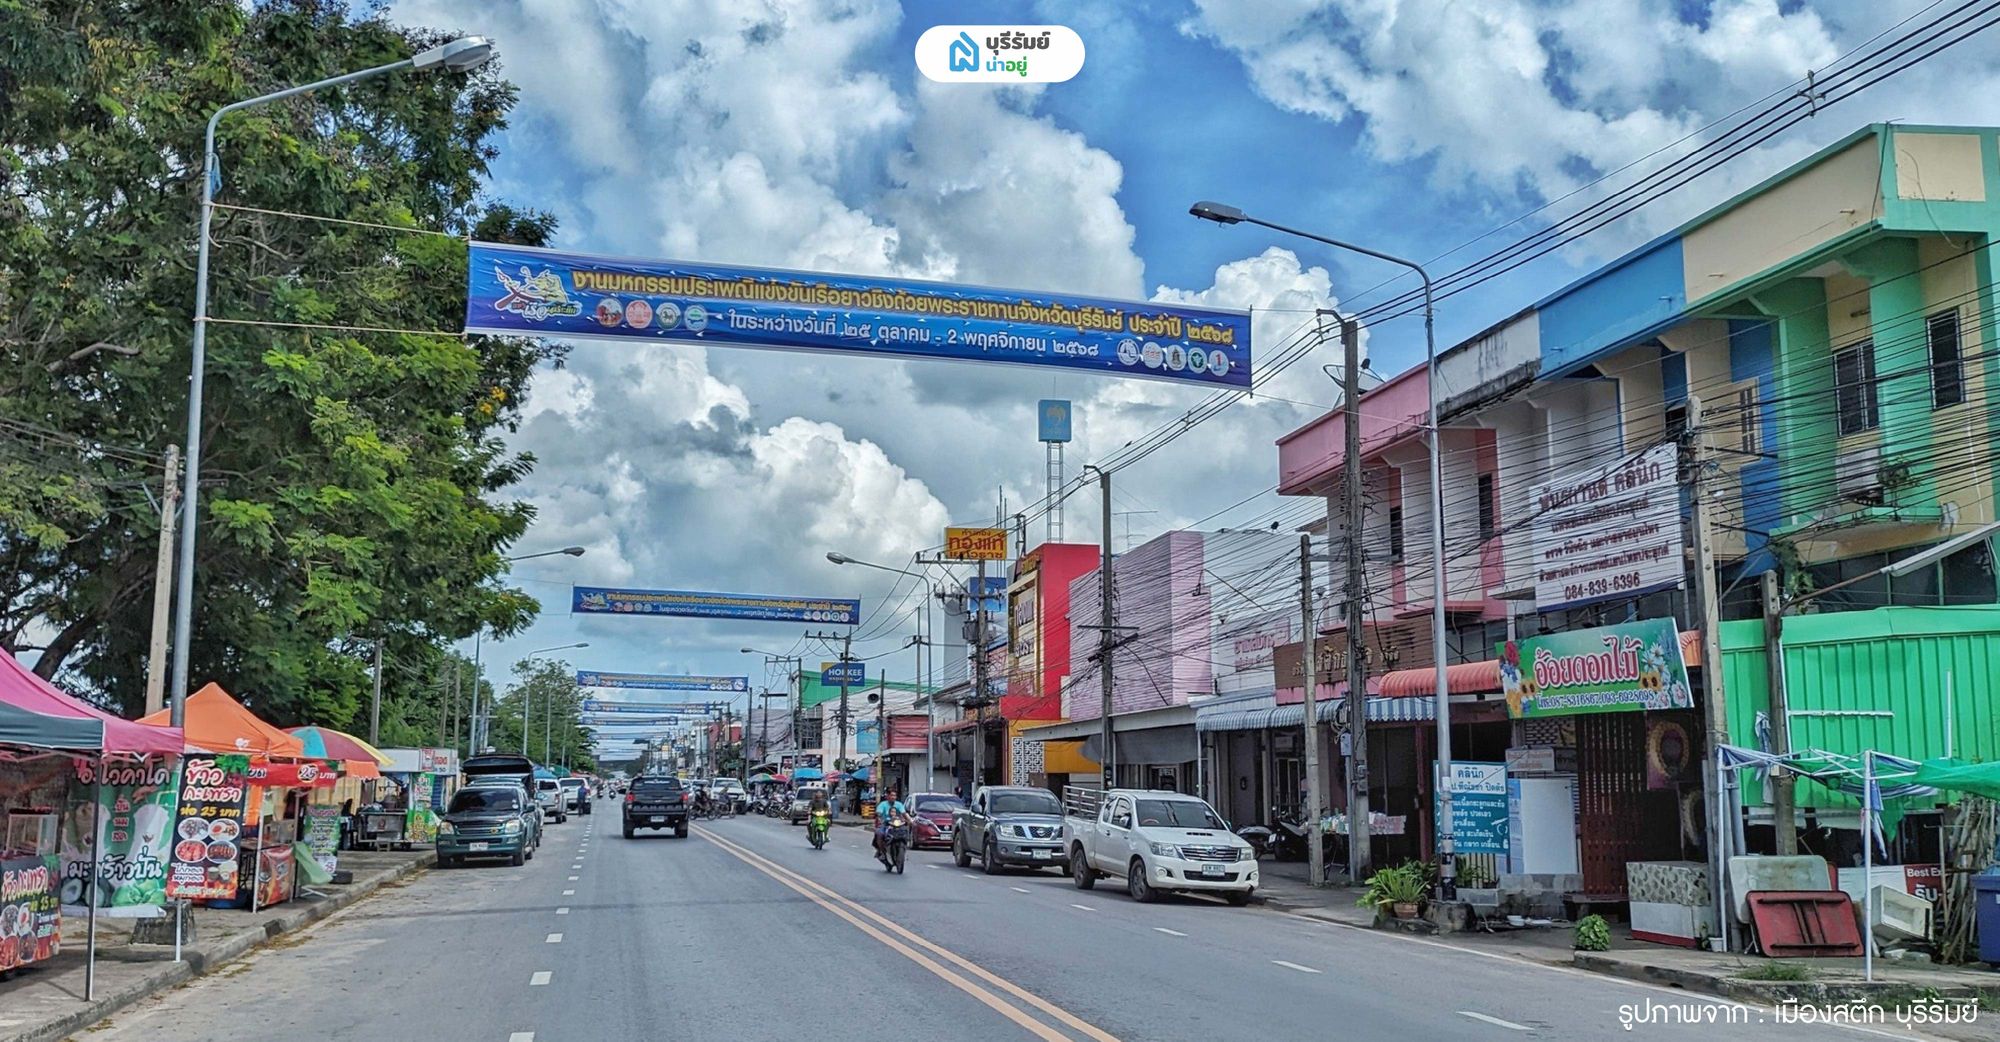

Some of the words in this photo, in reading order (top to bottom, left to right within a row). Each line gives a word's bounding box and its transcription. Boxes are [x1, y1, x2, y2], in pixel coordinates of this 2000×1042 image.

[571, 268, 1125, 334] งานมหกรรมประเพณีแข่งขันเรือยาวชิงถ้วยพระราชทานจังหวัดบุรีรัมย์
[1129, 313, 1182, 338] ประจำปี
[1185, 321, 1233, 345] ๒๕๖๘
[727, 308, 836, 336] ในระหว่างวันที่
[878, 324, 930, 346] ตุลาคม
[947, 330, 957, 345] 2
[963, 328, 1046, 352] พฤศจิกายน
[1051, 336, 1099, 358] ๒๕๖๘
[1615, 458, 1661, 493] คลินิก
[1564, 571, 1641, 601] 084-839-6396
[1533, 636, 1644, 689] อ้อยดอกไม้
[185, 759, 225, 786] ข้าว
[1457, 766, 1484, 779] คลินิก
[182, 785, 243, 804] กะเพรา
[200, 806, 217, 817] 25
[220, 808, 241, 818] บาท
[1907, 868, 1930, 878] Best
